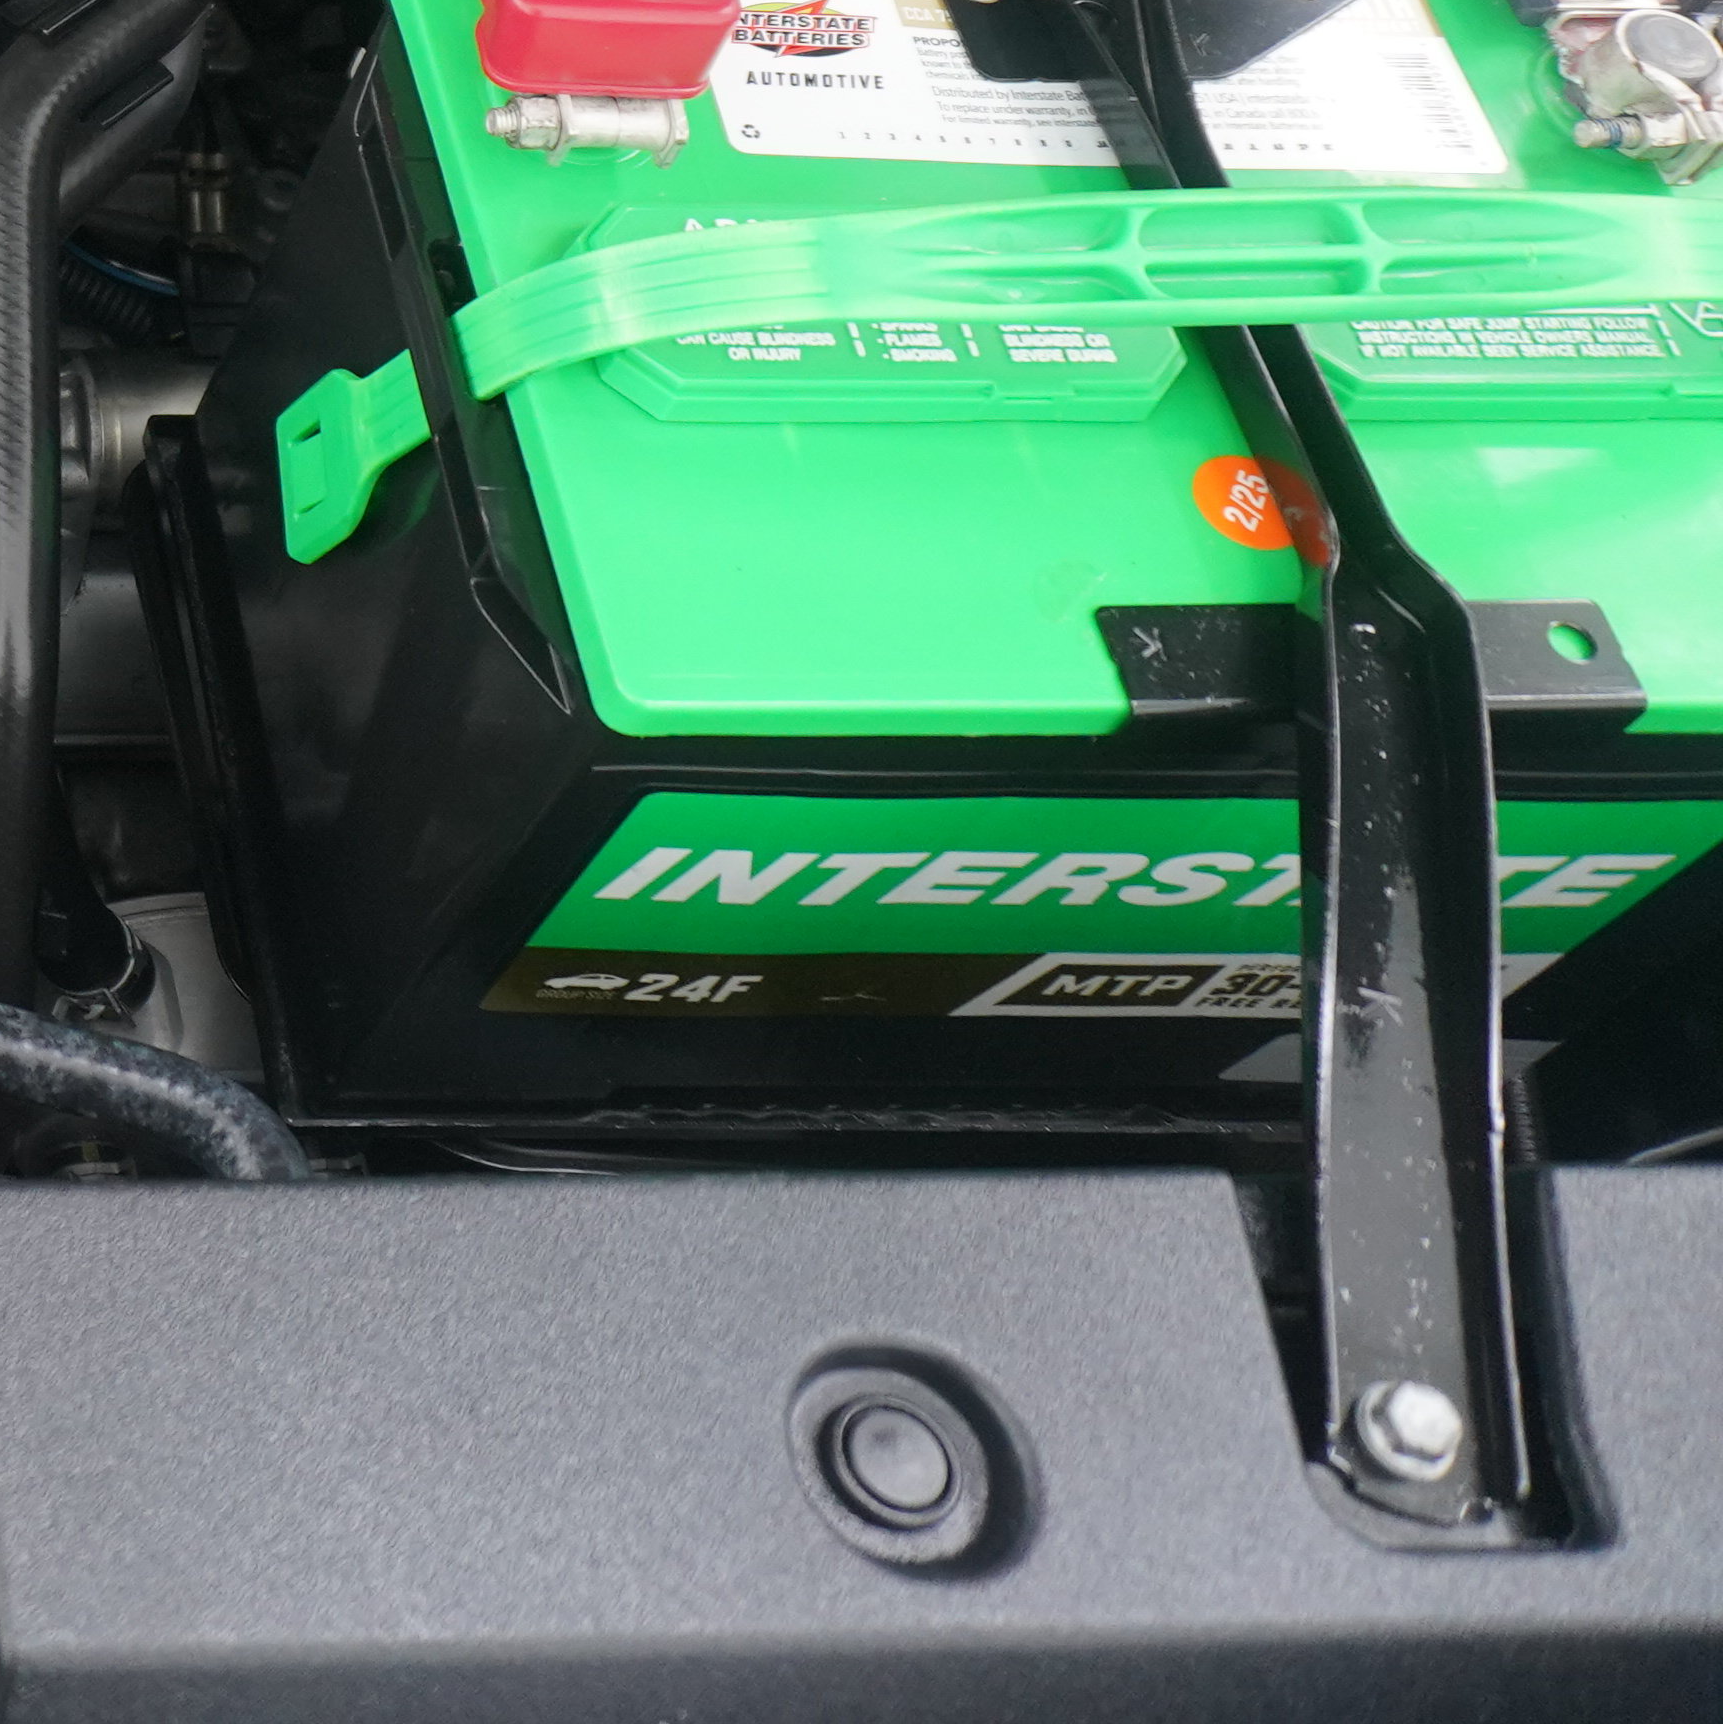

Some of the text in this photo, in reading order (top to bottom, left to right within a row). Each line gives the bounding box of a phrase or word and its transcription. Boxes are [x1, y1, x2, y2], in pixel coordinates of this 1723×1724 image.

[738, 12, 871, 32] NTERSTATE
[734, 28, 866, 48] BATTERIES
[913, 36, 964, 49] PROPO
[745, 71, 886, 91] AUTOMOTIVE
[931, 85, 995, 100] Distributed
[996, 86, 1010, 102] by
[1011, 88, 1065, 101] Interstate
[937, 101, 951, 113] To
[952, 103, 990, 117] replace
[992, 105, 1025, 116] under
[1446, 318, 1485, 331] SAFE
[1522, 317, 1593, 331] STARTING
[1593, 317, 1650, 331] FOLLOW
[708, 332, 756, 346] CAUSE
[756, 332, 837, 347] BLINDNESS
[884, 333, 943, 347] FLAMES
[1088, 334, 1111, 347] OR
[1357, 331, 1455, 344] INSTRUCTIONS
[1475, 331, 1532, 344] VEHICLE
[891, 348, 958, 363] SMOKING
[1378, 345, 1408, 358] NOT
[1410, 345, 1482, 358] AVAILABLE
[1482, 345, 1519, 358] SEEK
[1519, 345, 1579, 358] SERVICE
[1222, 469, 1271, 533] 2/25
[593, 846, 1677, 908] INTERSTTE
[622, 972, 765, 1003] 24F
[1041, 974, 1201, 999] MTP
[1208, 972, 1301, 997] 30-
[1195, 997, 1264, 1009] FREE
